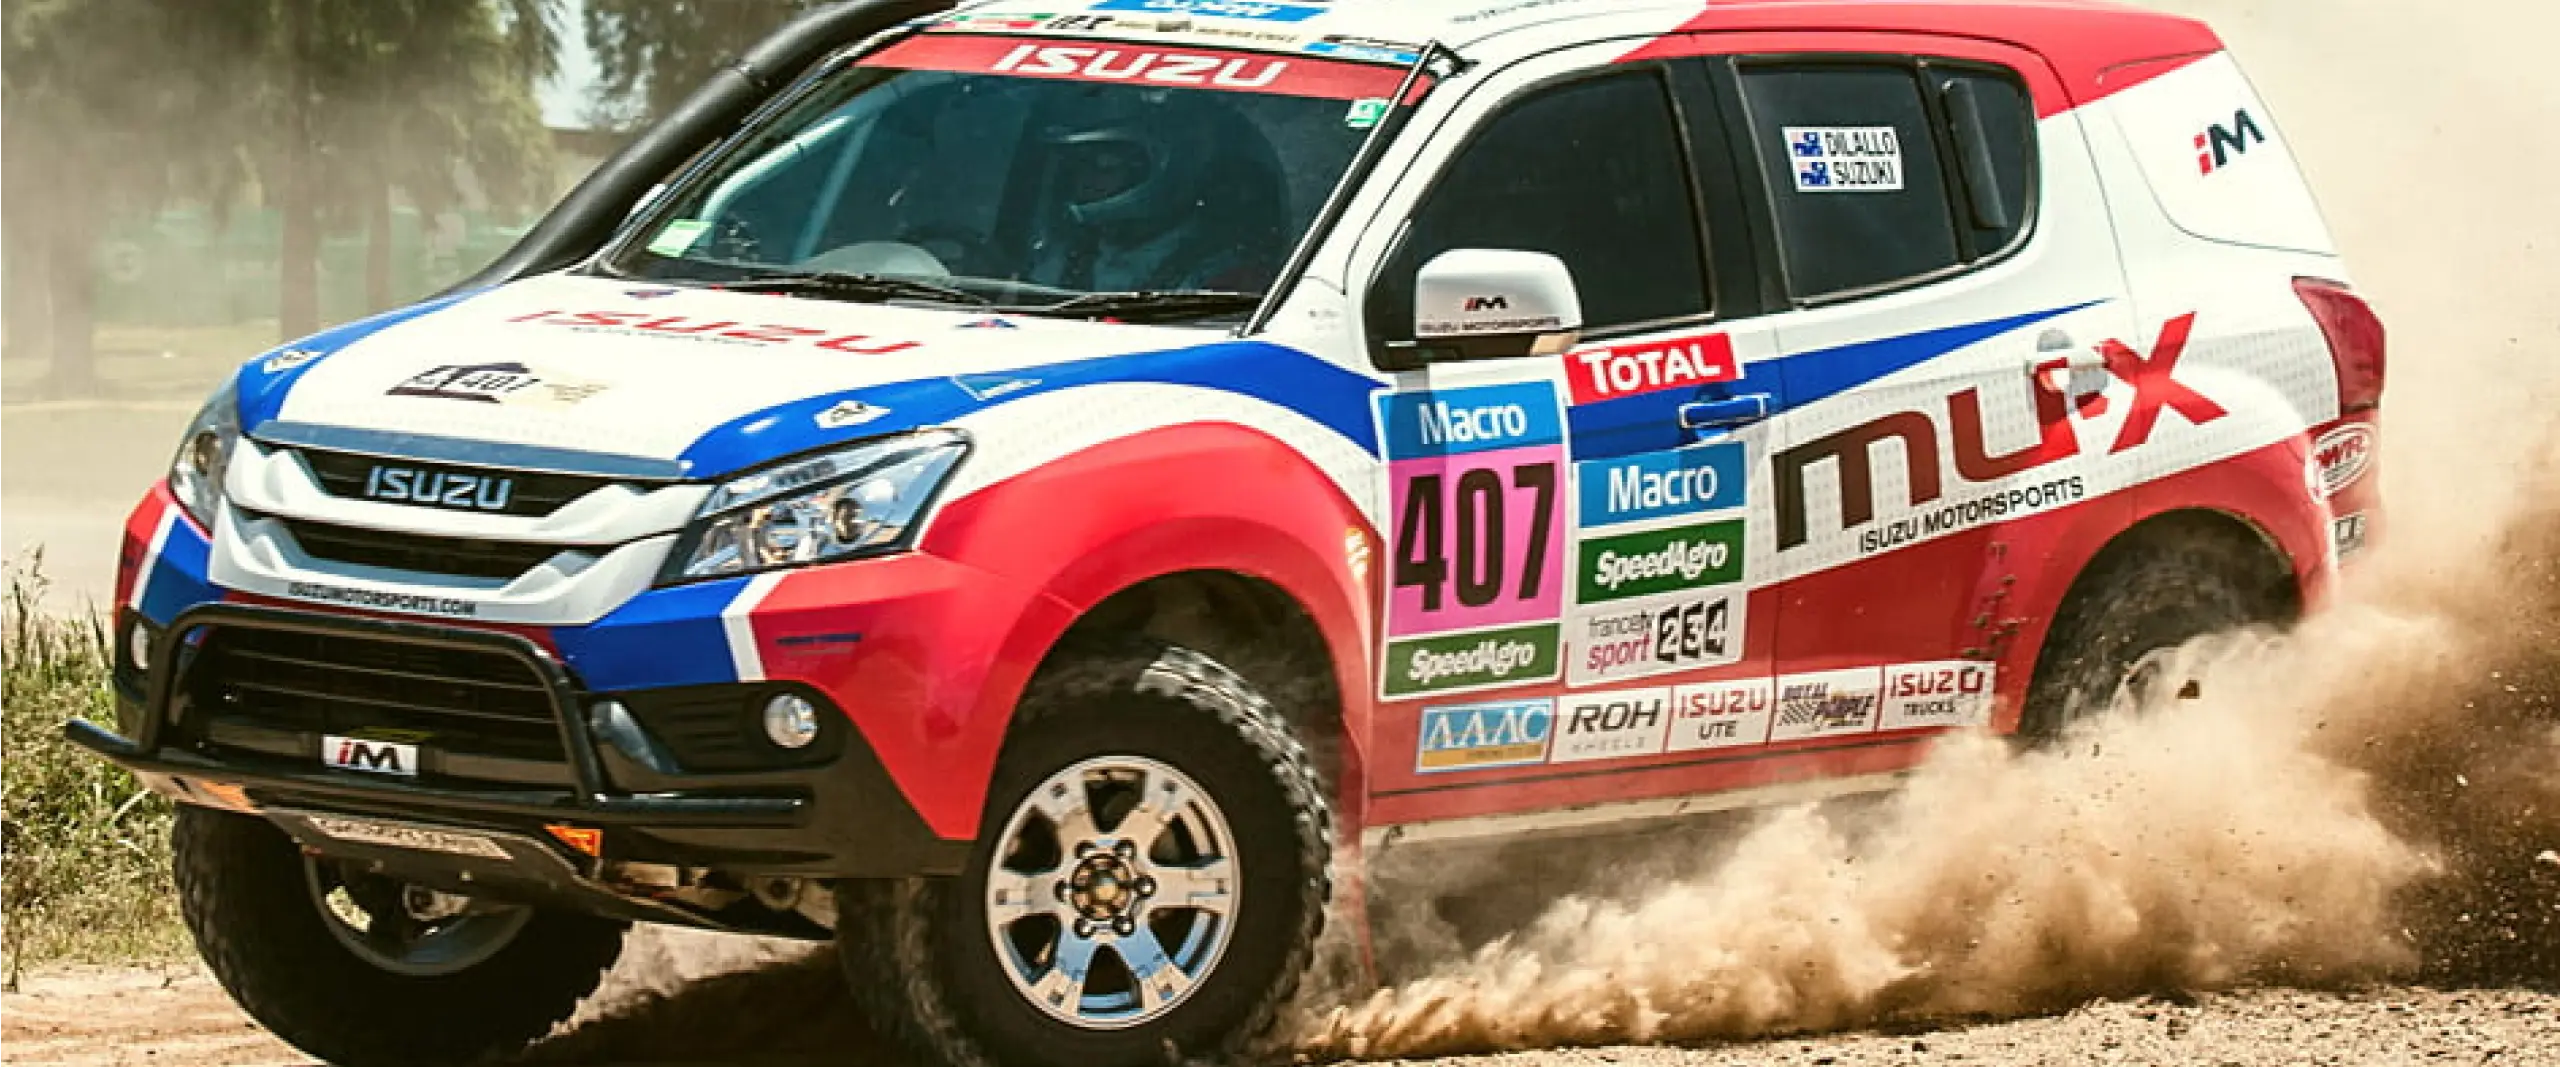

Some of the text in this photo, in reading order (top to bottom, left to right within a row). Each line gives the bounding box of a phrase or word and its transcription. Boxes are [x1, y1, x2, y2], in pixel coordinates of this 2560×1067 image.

[992, 44, 1291, 88] ISUZU
[1825, 131, 1897, 158] DILALLO
[1833, 160, 1896, 187] SUZUKI
[506, 310, 924, 355] ISUZU
[1419, 400, 1527, 446] Macro
[365, 466, 513, 511] ISUZU
[1607, 461, 1719, 513] Macro
[1394, 461, 1556, 613] 407
[1859, 476, 2086, 554] ISUZU MOTORSPORTS
[1594, 537, 1729, 591] SpeedAgro
[1409, 642, 1537, 683] SpeedAgro
[1586, 631, 1651, 676] sport
[1679, 687, 1767, 719] ISUZU
[1889, 666, 1986, 698] ISUZU
[1424, 703, 1551, 750] AAAC
[1566, 698, 1662, 735] ROH
[1698, 720, 1738, 740] UTE
[1903, 701, 1956, 717] TRUCKS
